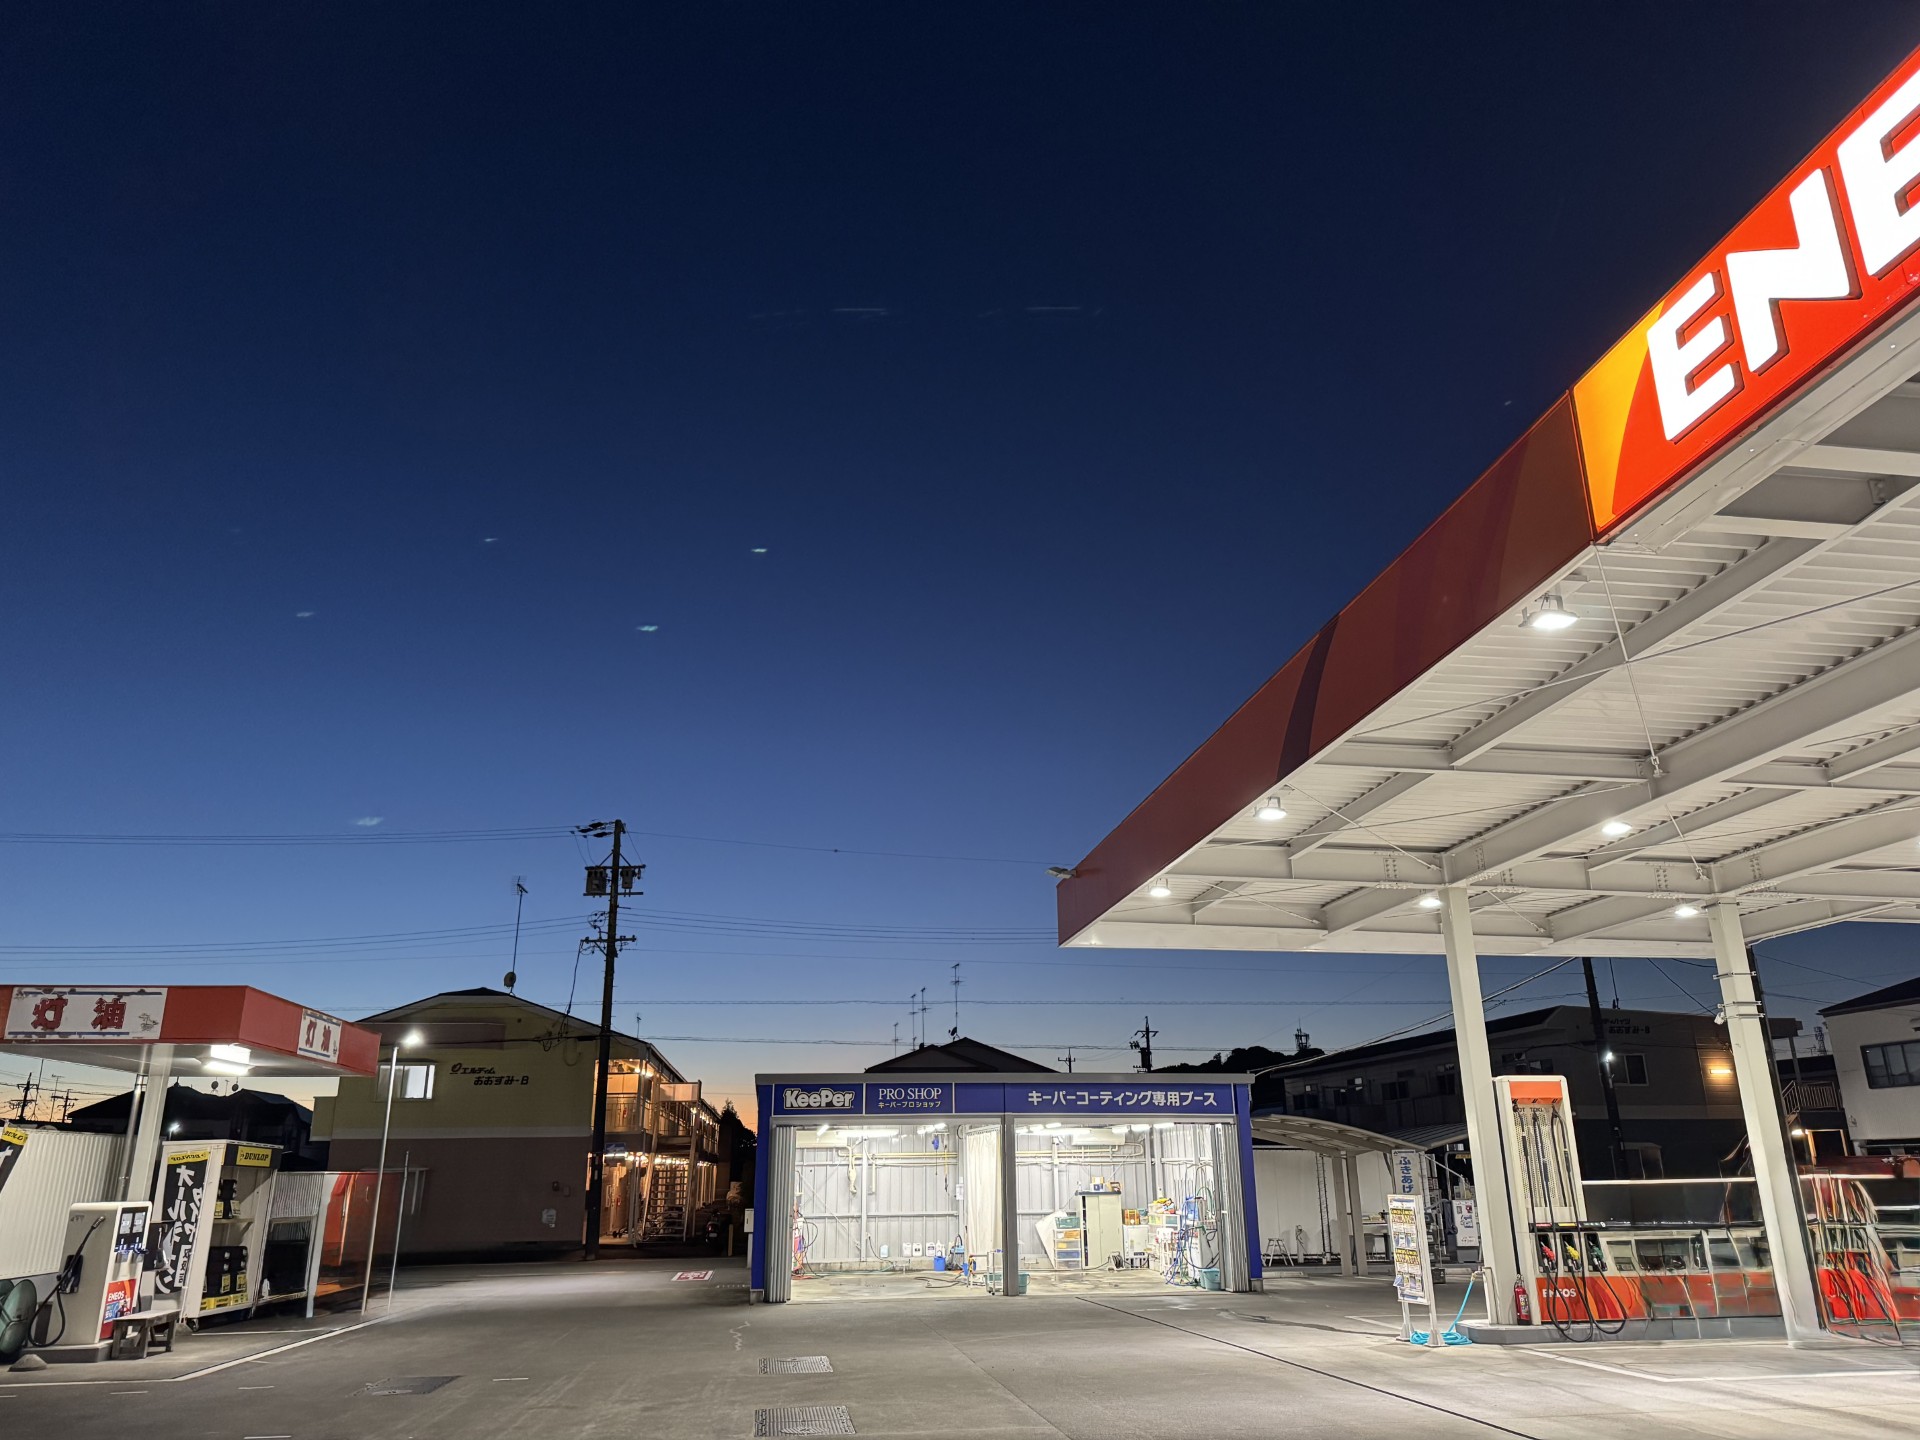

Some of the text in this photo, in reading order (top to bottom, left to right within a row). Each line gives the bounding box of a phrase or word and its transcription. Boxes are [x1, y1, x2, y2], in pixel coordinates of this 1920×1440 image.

[31, 997, 126, 1030] 灯油
[784, 1089, 854, 1108] KeePer
[878, 1087, 942, 1100] PRO SHOP
[1028, 1090, 1218, 1107] キーパーコーティング専用ブース
[878, 1101, 941, 1109] キーパープロショップ
[244, 1152, 269, 1161] DUNLOP
[1399, 1156, 1414, 1193] ふきあげ
